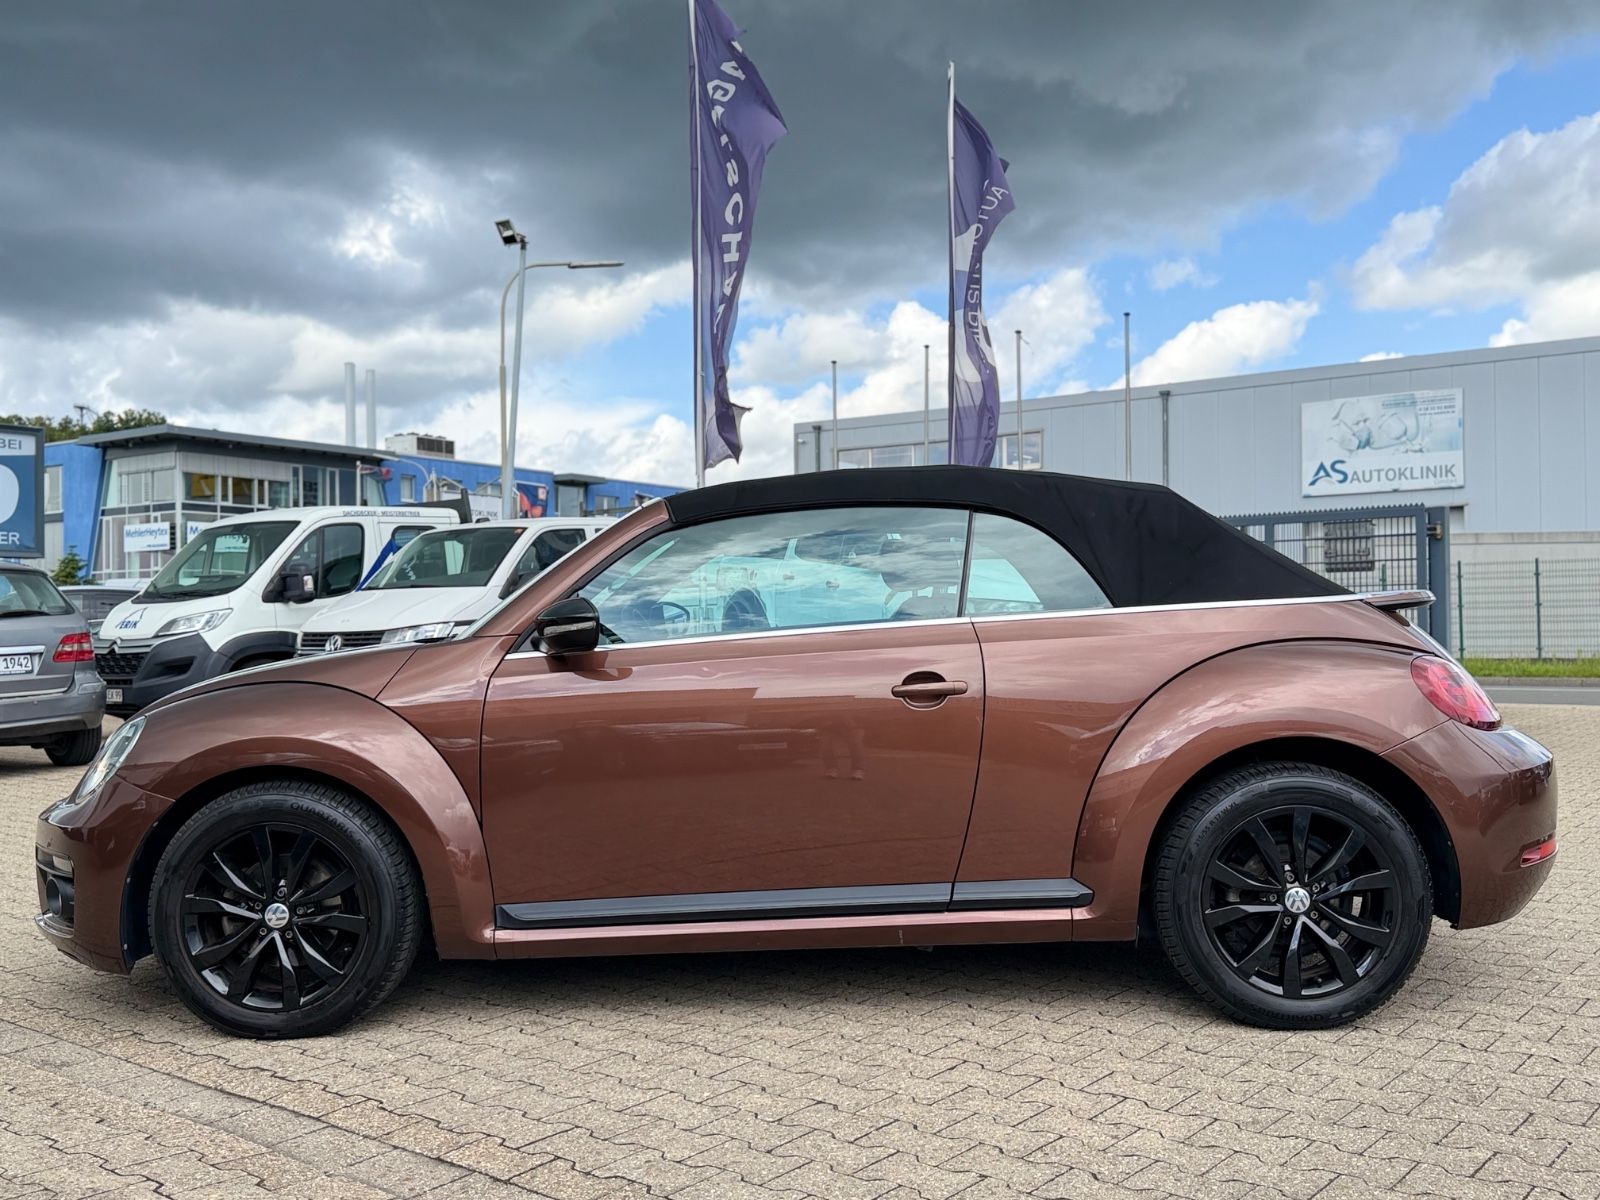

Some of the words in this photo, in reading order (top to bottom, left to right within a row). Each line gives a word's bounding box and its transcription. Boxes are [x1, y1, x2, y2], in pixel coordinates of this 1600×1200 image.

[1308, 460, 1348, 486] AS
[1349, 464, 1456, 484] AUTOKLINIK
[2, 656, 31, 670] 1942
